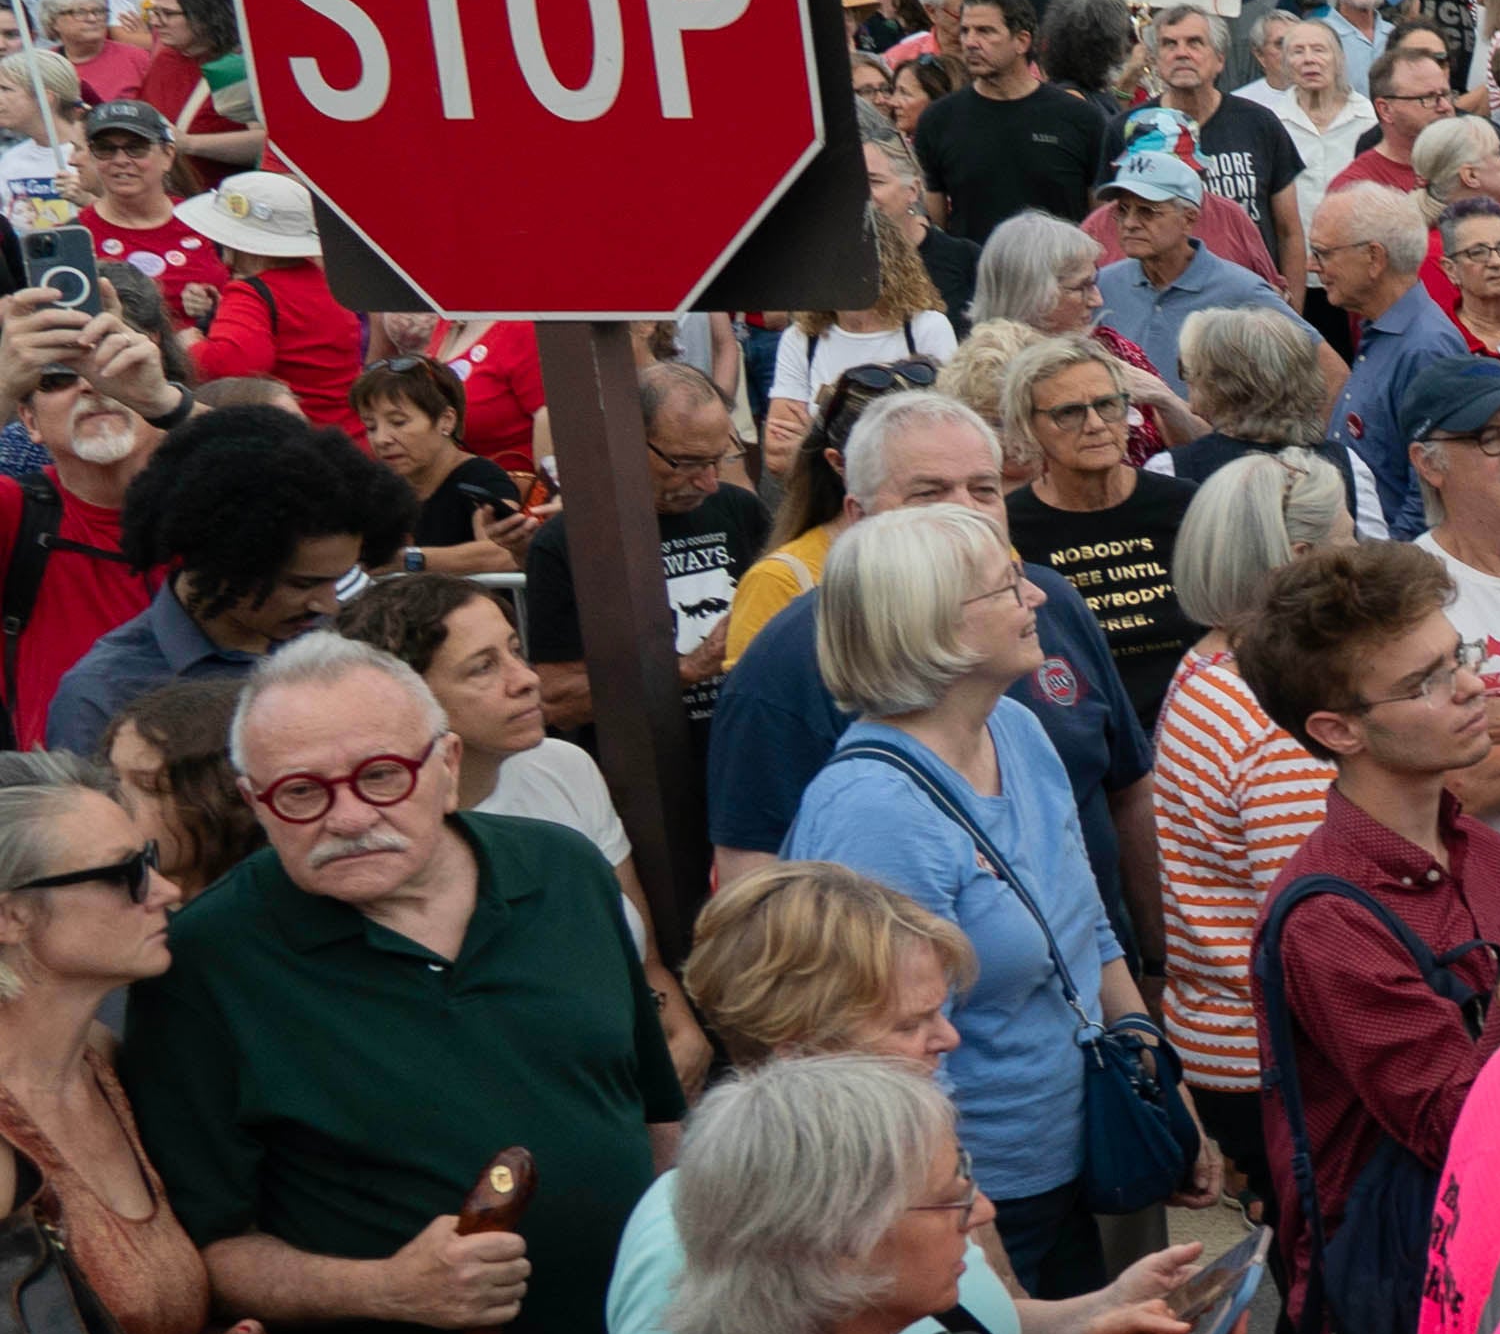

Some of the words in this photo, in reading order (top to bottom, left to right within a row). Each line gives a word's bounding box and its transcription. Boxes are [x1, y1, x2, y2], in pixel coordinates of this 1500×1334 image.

[1206, 151, 1256, 178] MORE
[686, 532, 729, 549] country
[1049, 536, 1155, 566] NOBODY'S
[663, 545, 737, 577] WAYS.
[1107, 560, 1168, 586] UNTIL
[1086, 584, 1176, 612] RYBODY'
